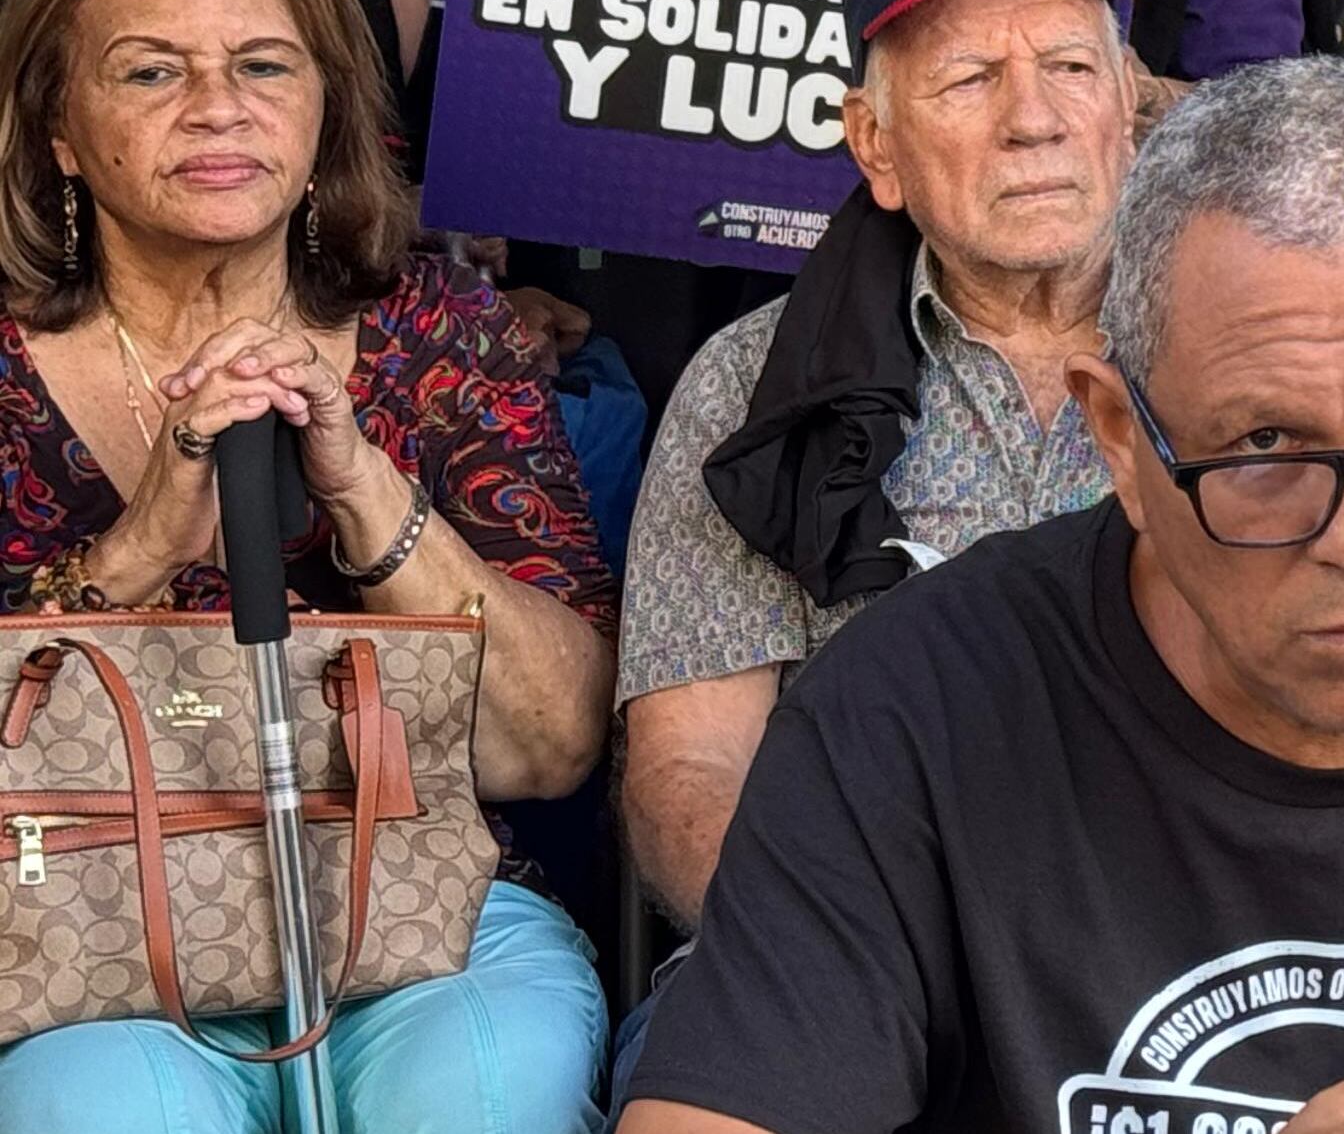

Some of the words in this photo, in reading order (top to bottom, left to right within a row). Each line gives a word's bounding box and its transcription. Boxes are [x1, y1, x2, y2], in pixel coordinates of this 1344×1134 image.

[553, 40, 629, 120] Y
[659, 55, 846, 150] LUC
[721, 201, 831, 231] CONSTRUYAMOS
[1140, 967, 1322, 1072] CONSTRUYAMOS
